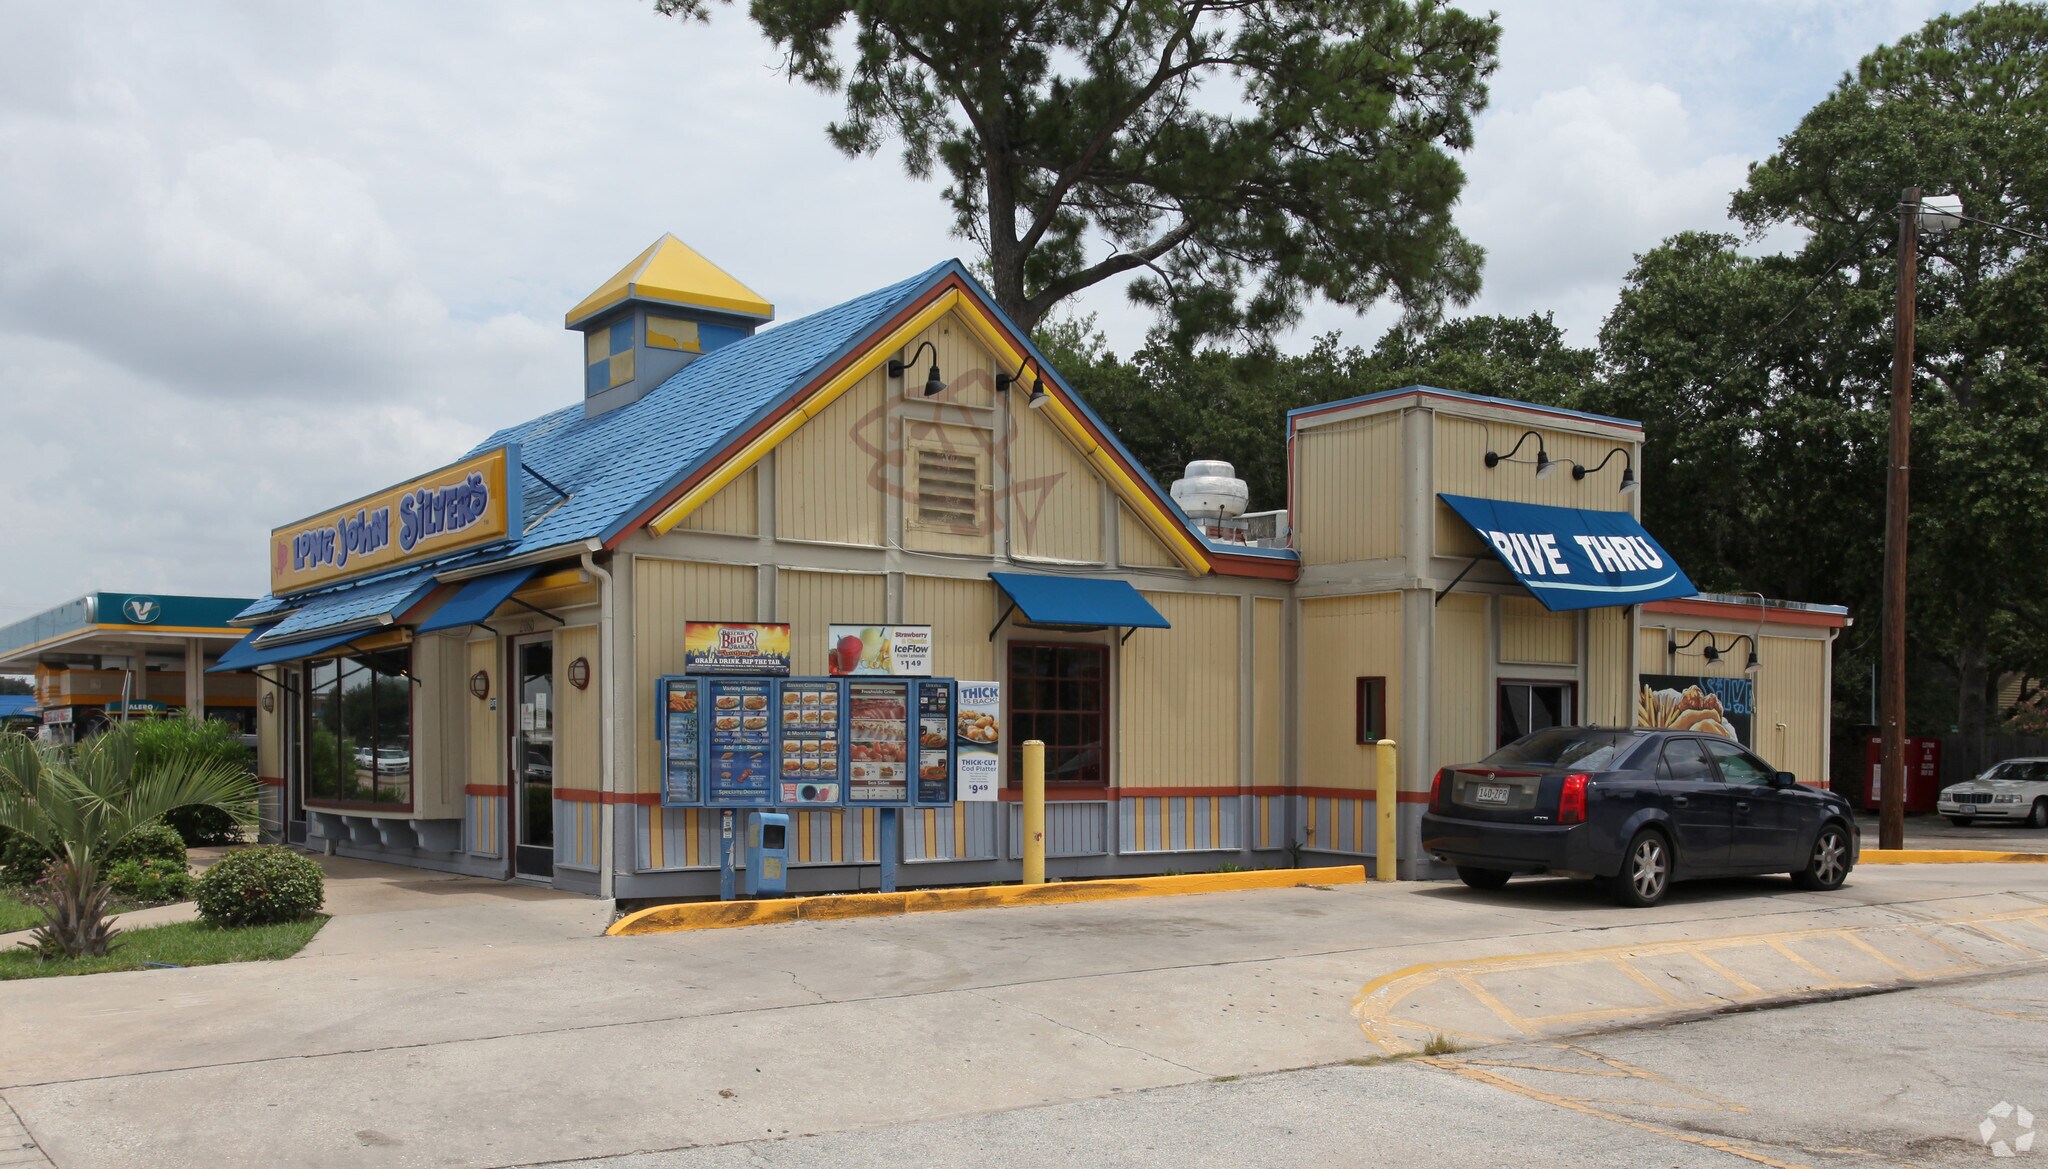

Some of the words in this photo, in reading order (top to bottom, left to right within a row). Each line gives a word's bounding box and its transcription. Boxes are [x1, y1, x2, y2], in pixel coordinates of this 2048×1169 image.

[1478, 528, 1570, 575] RIVE
[1573, 535, 1663, 574] THRU
[720, 632, 755, 649] BOOTS
[894, 645, 928, 653] IceFlow
[961, 687, 998, 698] THICK
